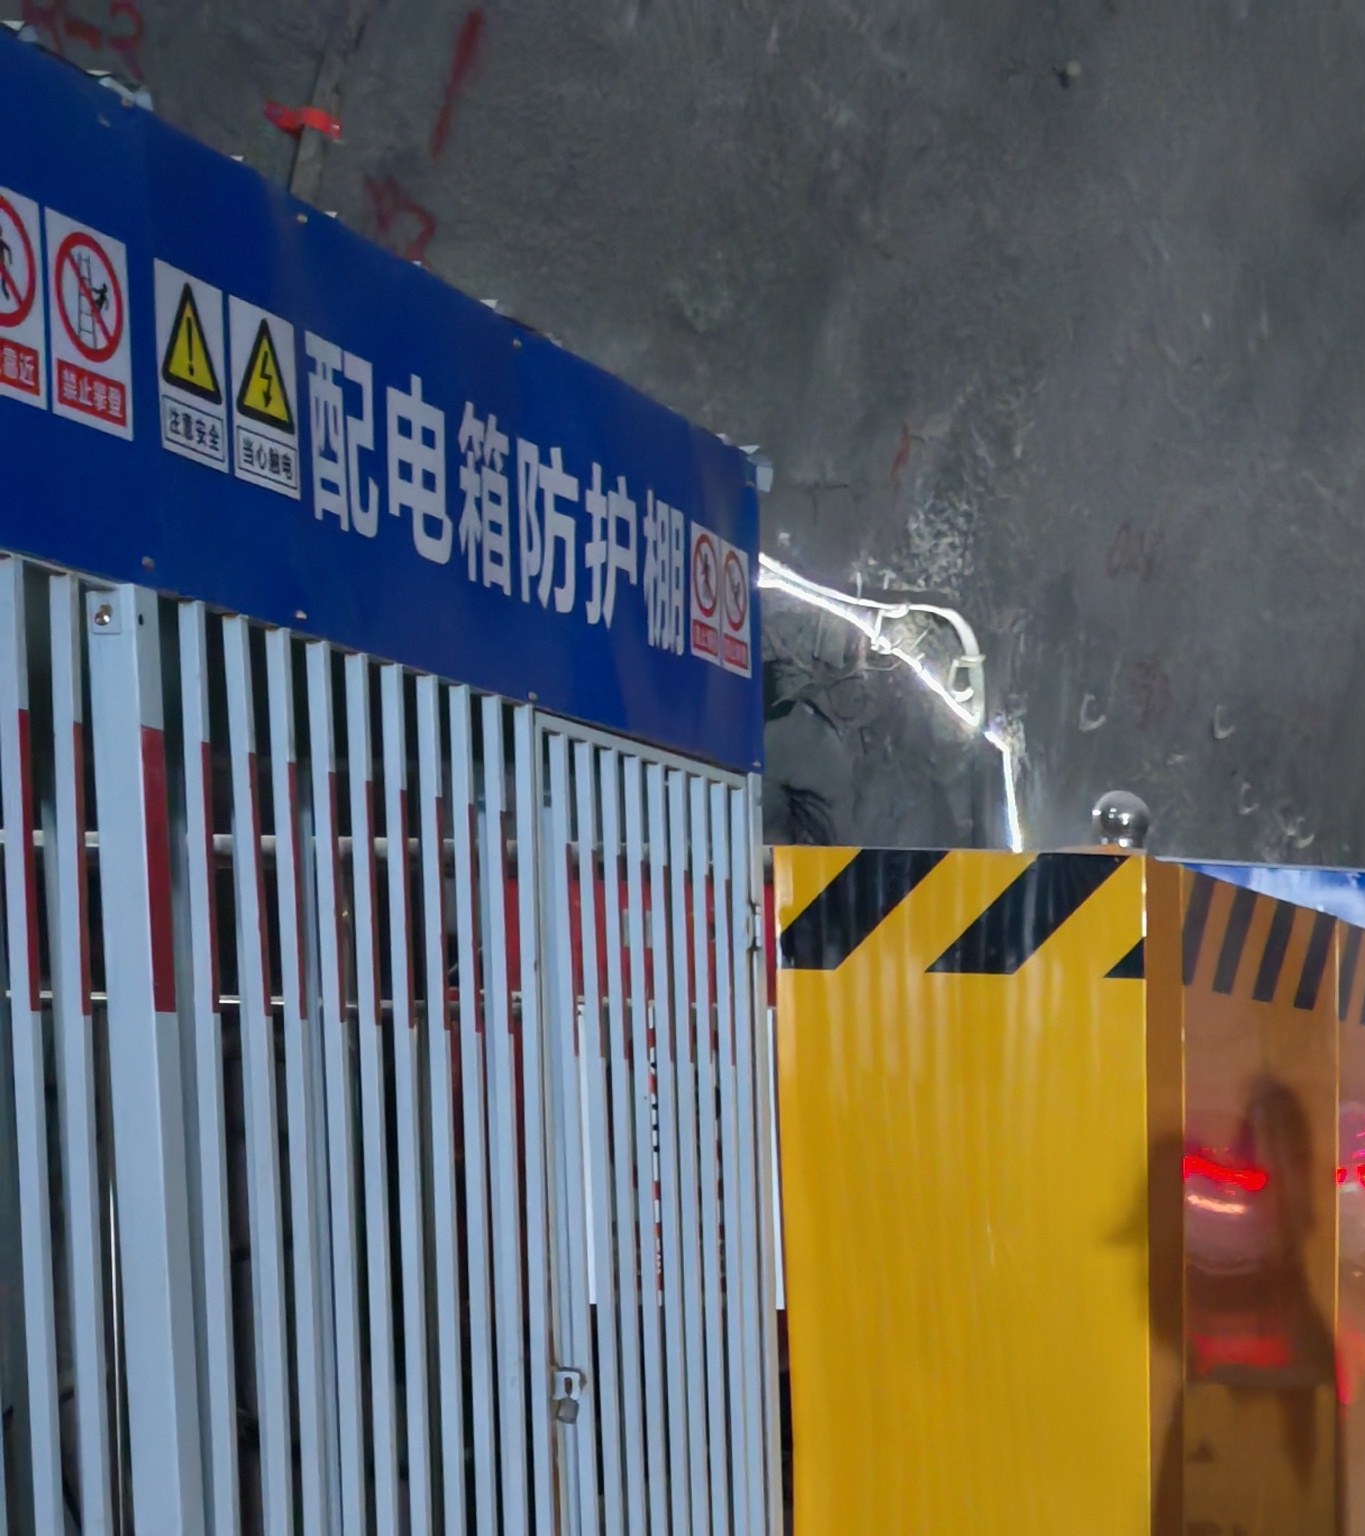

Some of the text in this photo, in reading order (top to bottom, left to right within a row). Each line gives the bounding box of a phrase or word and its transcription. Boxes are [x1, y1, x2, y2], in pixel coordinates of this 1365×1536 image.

[168, 410, 222, 452] 注意安全
[305, 330, 684, 656] 配电箱防护棚
